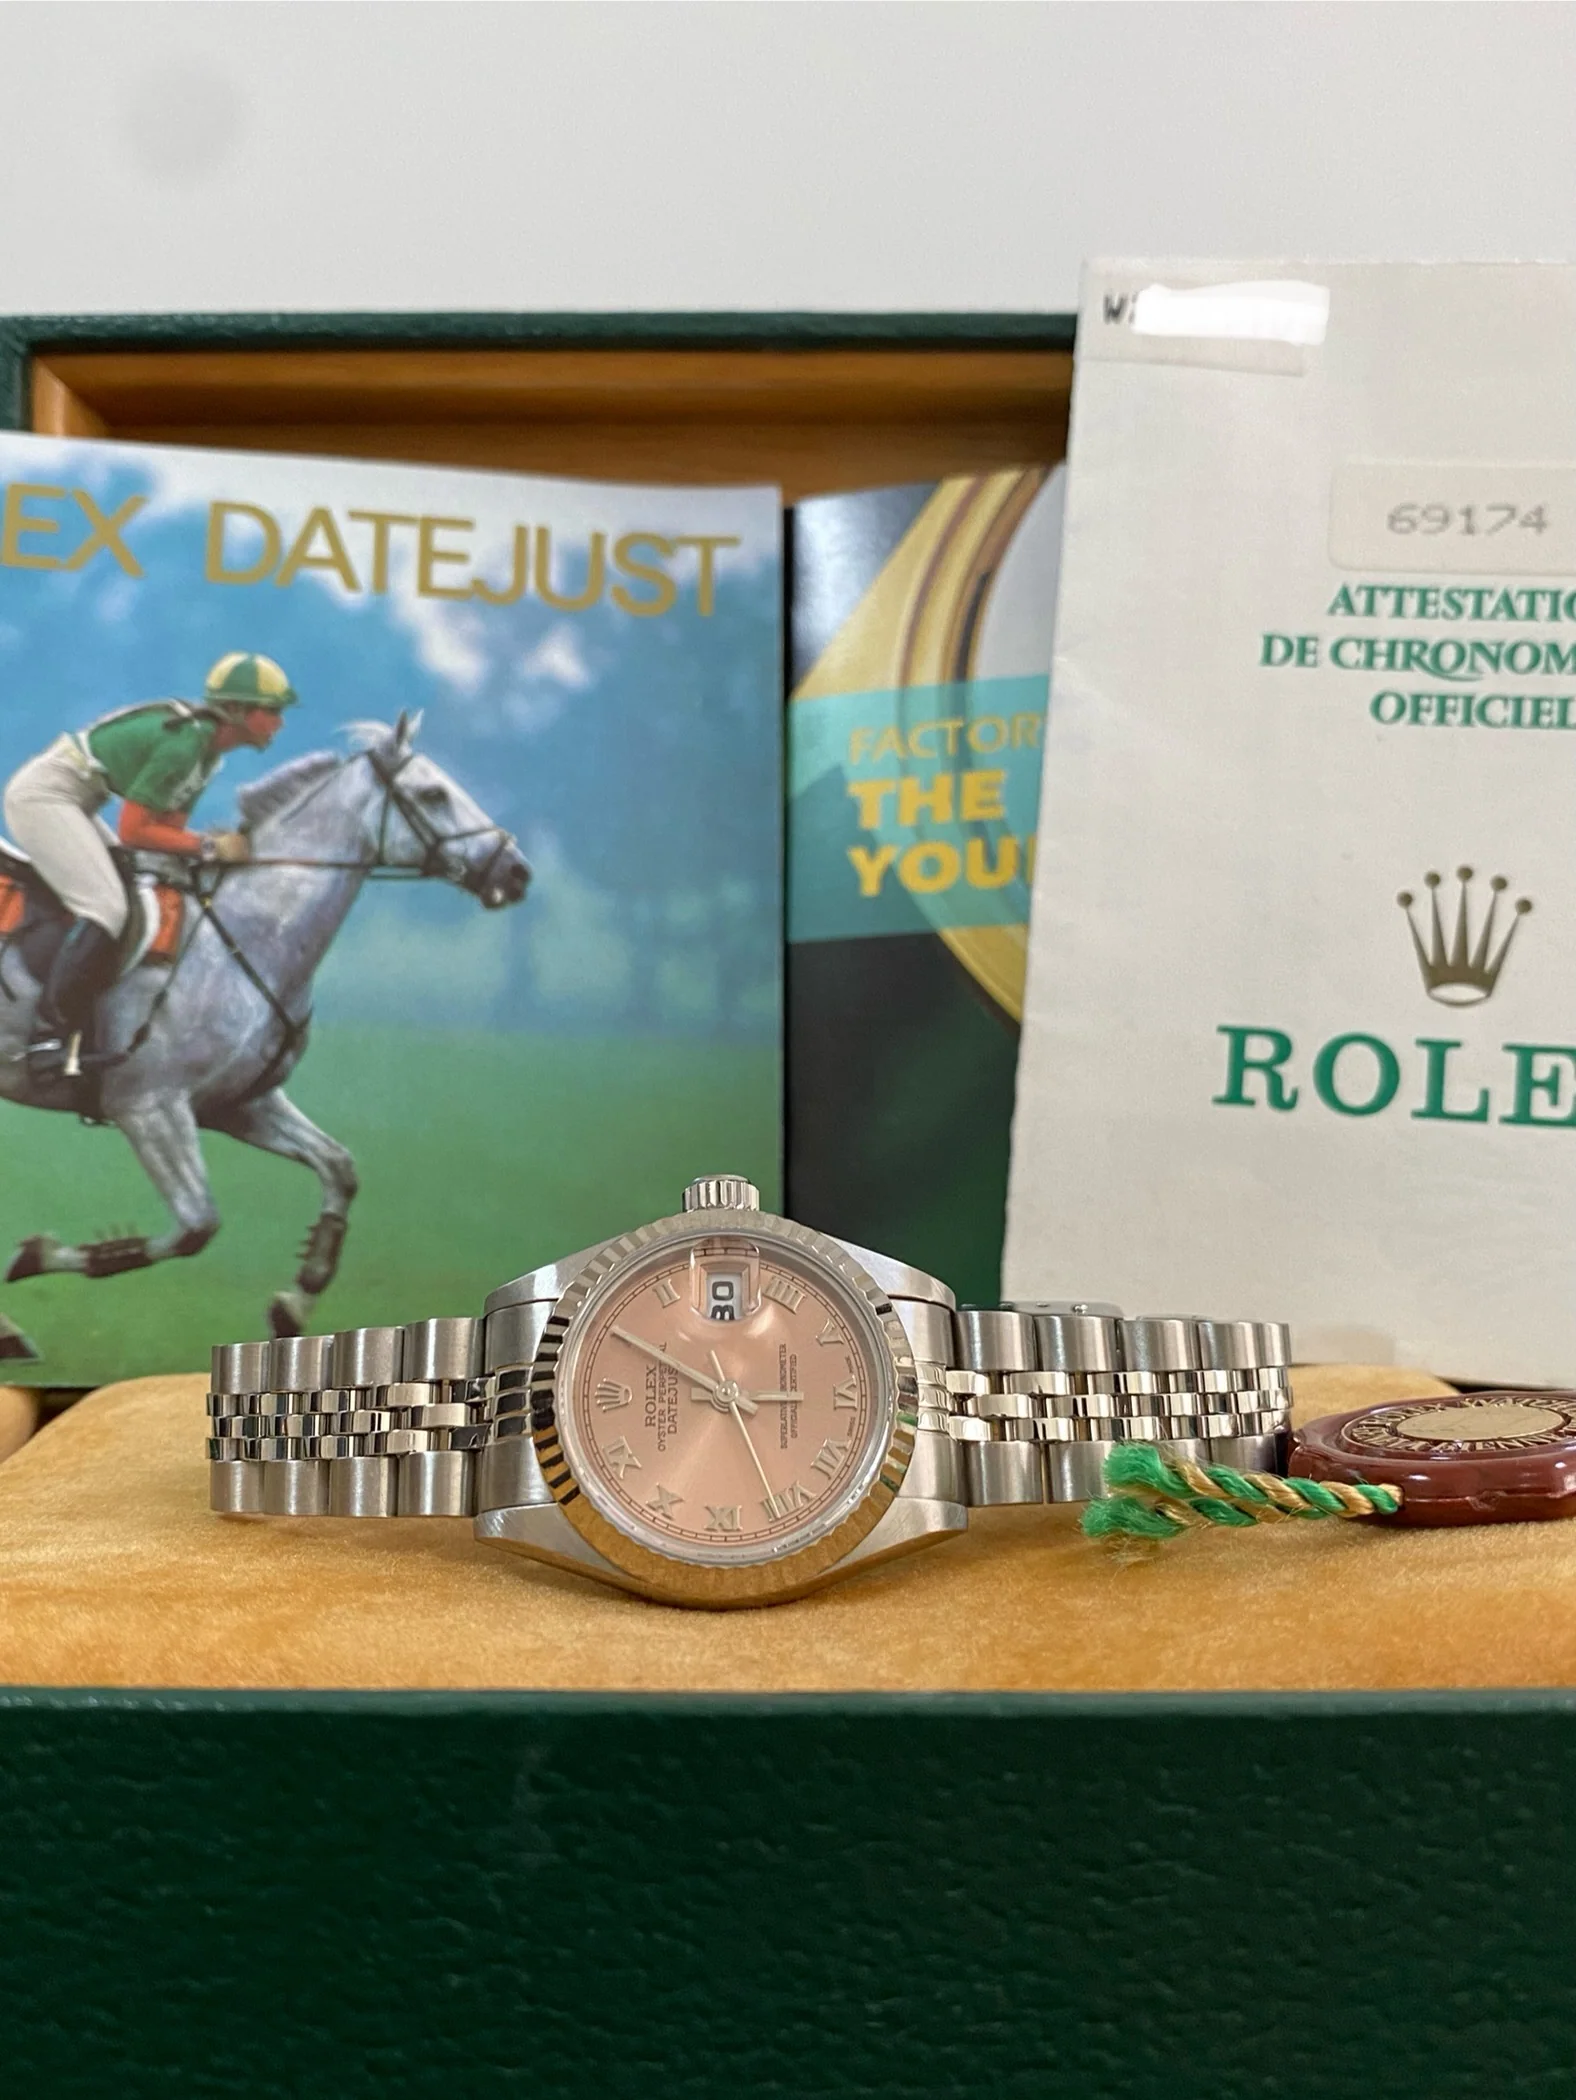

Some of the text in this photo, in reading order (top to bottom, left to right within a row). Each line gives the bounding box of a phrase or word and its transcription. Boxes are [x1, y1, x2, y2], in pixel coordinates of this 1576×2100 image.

[0, 483, 741, 617] EX DATEJUST
[1386, 503, 1548, 536] 69174
[1260, 633, 1576, 682] DE CHRONOM
[847, 769, 1008, 830] THE
[847, 834, 1037, 896] YOU
[1211, 1025, 1576, 1127] ROLE
[645, 1363, 657, 1428] ROLEX
[657, 1341, 667, 1452] OYSTER PERPETAL
[667, 1366, 678, 1435] DATEJUS
